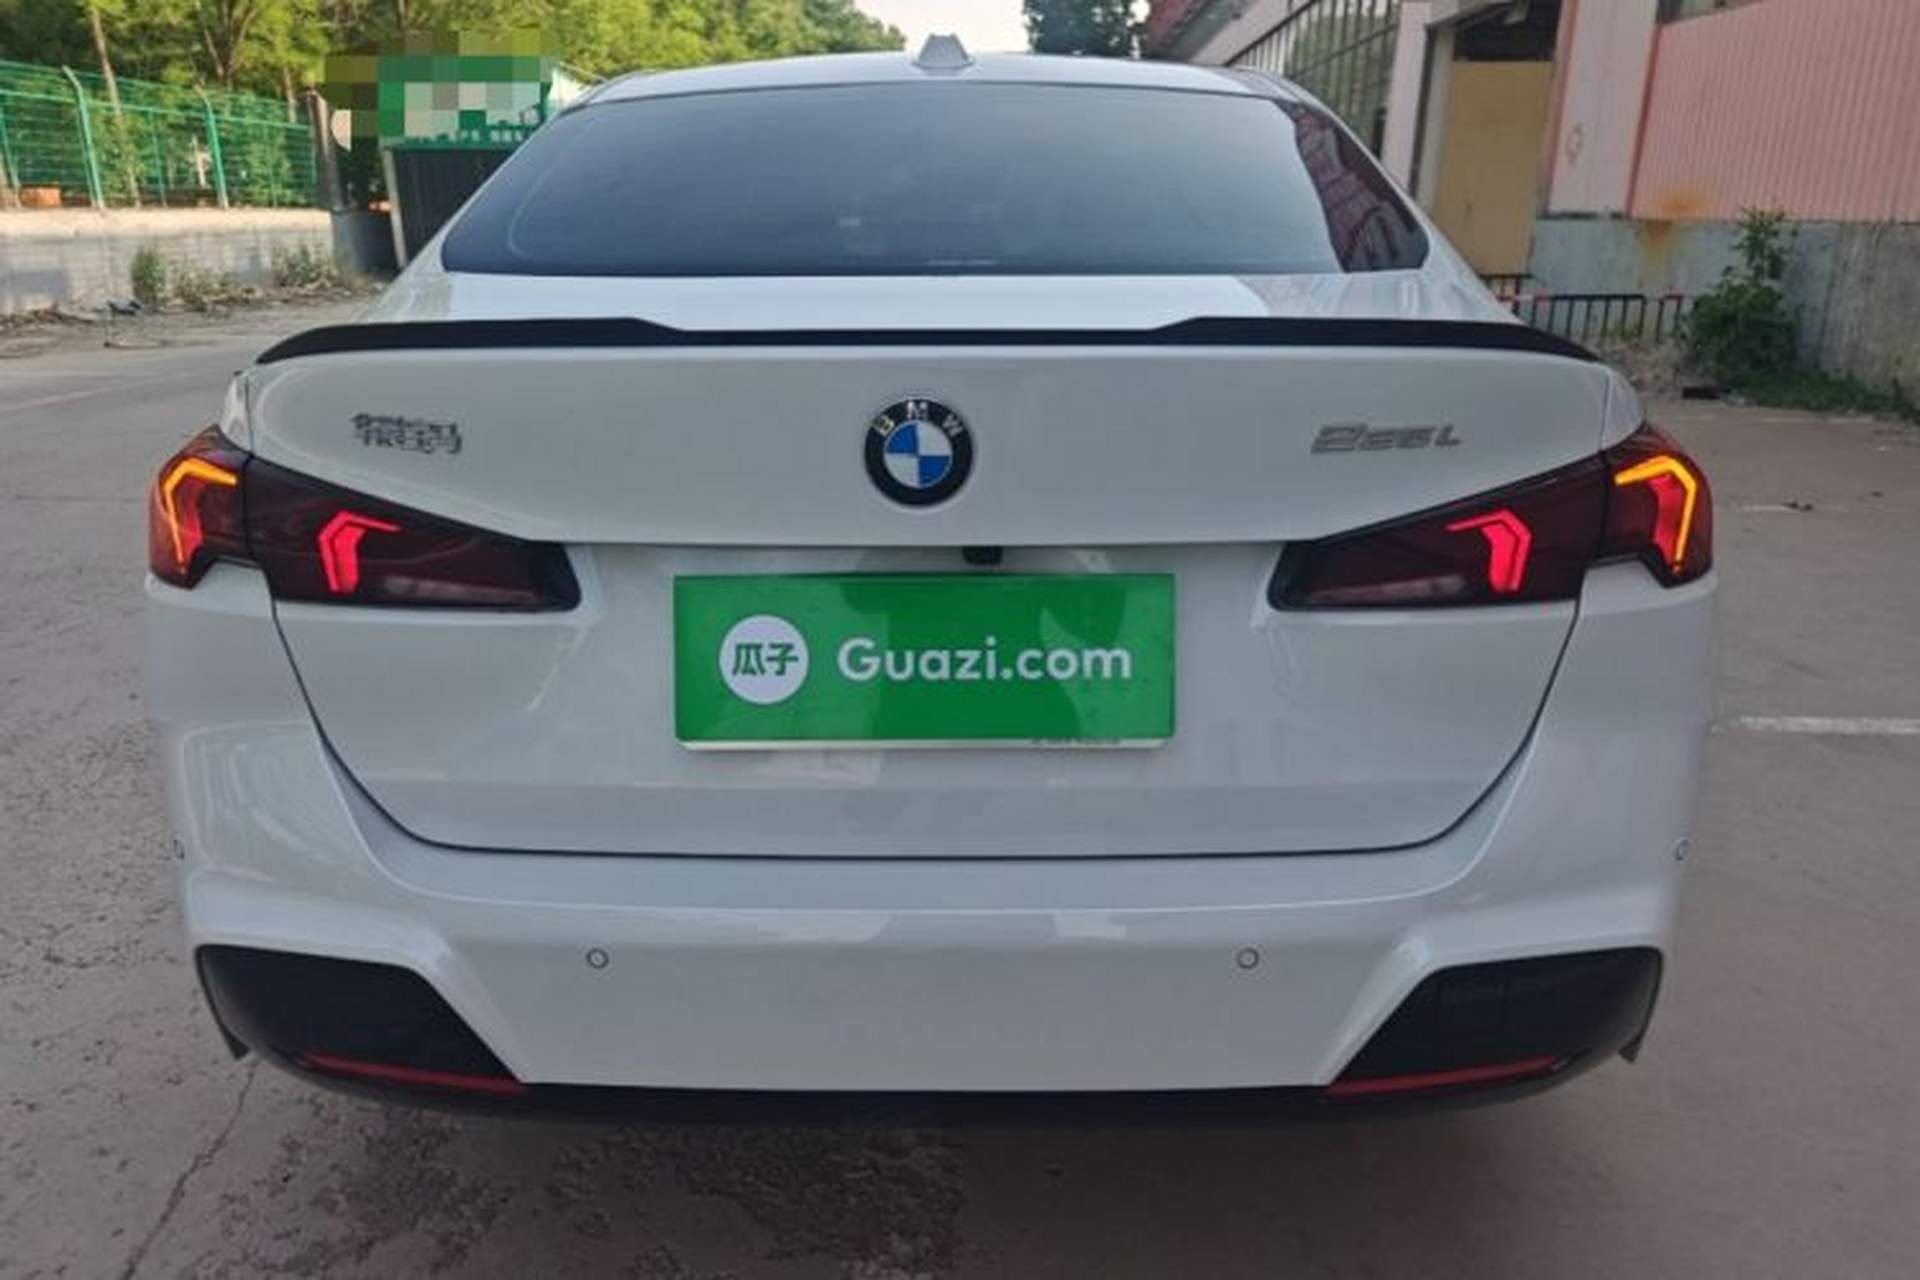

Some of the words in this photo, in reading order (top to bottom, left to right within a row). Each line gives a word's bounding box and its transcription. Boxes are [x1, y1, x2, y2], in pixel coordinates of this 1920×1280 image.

[873, 400, 964, 437] BMW
[732, 643, 799, 676] 瓜子
[837, 636, 1132, 682] Guazi.com
